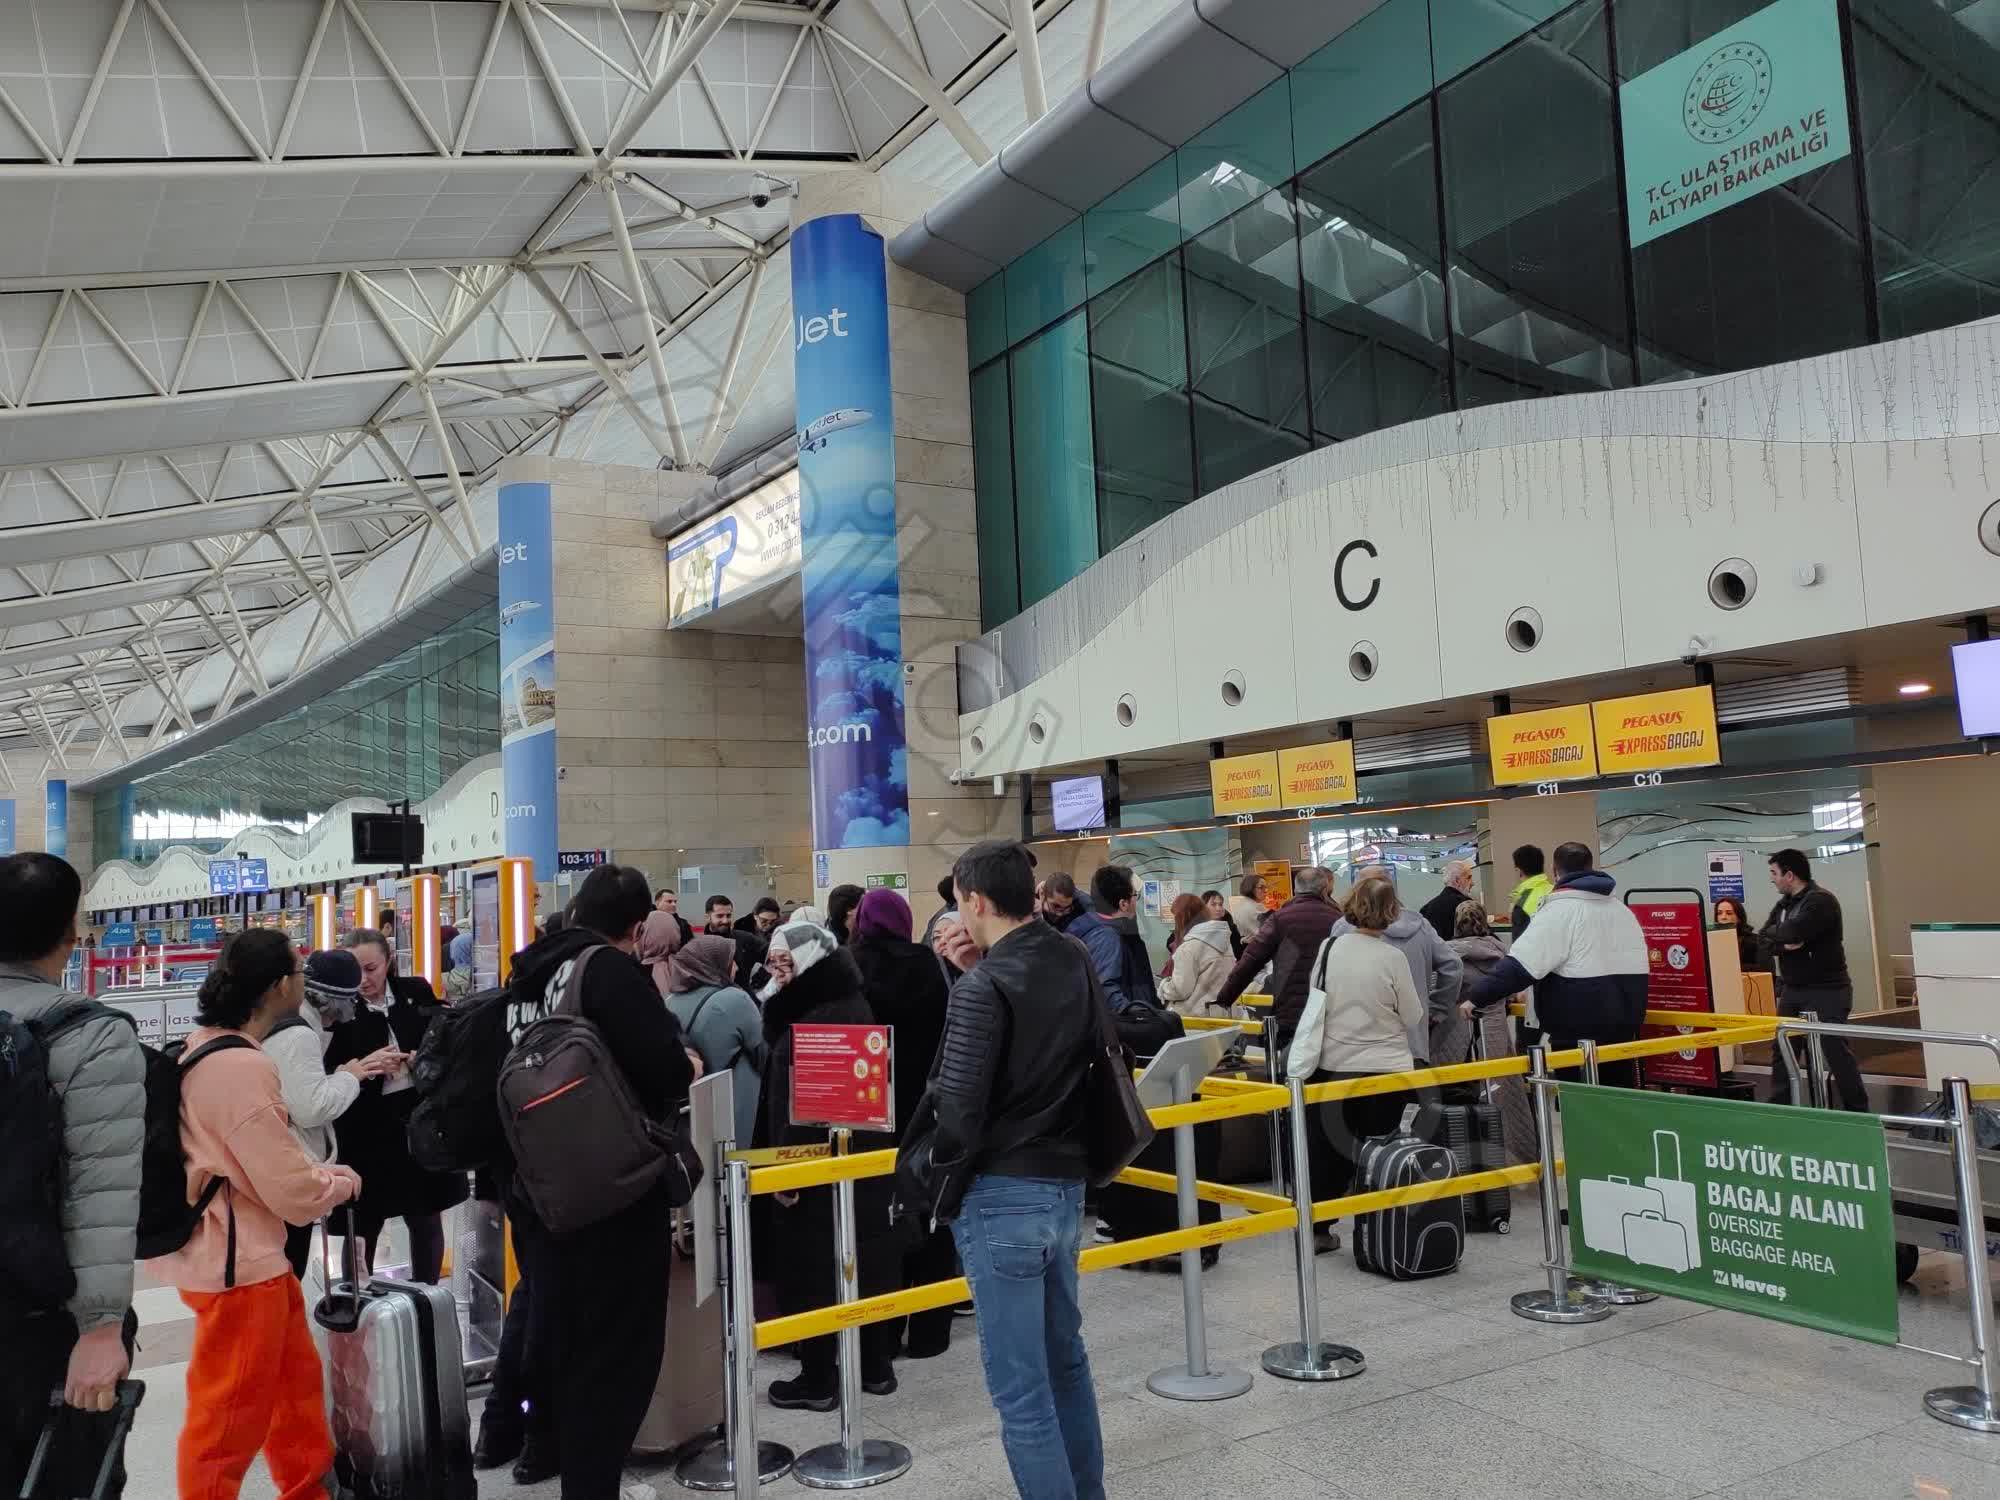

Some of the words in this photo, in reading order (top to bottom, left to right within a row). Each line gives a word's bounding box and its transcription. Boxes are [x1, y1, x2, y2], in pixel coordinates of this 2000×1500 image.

[1645, 181, 1676, 204] T.C.
[1681, 125, 1795, 187] ULAŞTIRMA
[1801, 109, 1827, 133] VE
[1648, 182, 1718, 226] ALTYAPI
[1723, 131, 1829, 192] BAKANLIĞI
[1334, 539, 1381, 611] C
[1622, 710, 1687, 729] PEGASUS
[1513, 727, 1567, 743] PEGASUS
[1227, 769, 1262, 782] PEGASUS
[1296, 760, 1334, 772] PEGASUS
[1537, 783, 1558, 796] C11
[1634, 772, 1662, 787] C10
[491, 791, 499, 818] D
[1298, 809, 1315, 819] C12
[1237, 814, 1254, 824] C13
[1078, 830, 1091, 839] C14
[1704, 1141, 1784, 1179] BÜYÜK
[1790, 1156, 1877, 1192] EBATLI
[1707, 1181, 1782, 1217] BAGAJ
[1790, 1194, 1865, 1230] ALANI
[1708, 1213, 1784, 1241] OVERSIZE
[1711, 1236, 1787, 1266] BAGGAGE
[1792, 1251, 1836, 1275] AREA
[1730, 1272, 1788, 1301] Havaş
